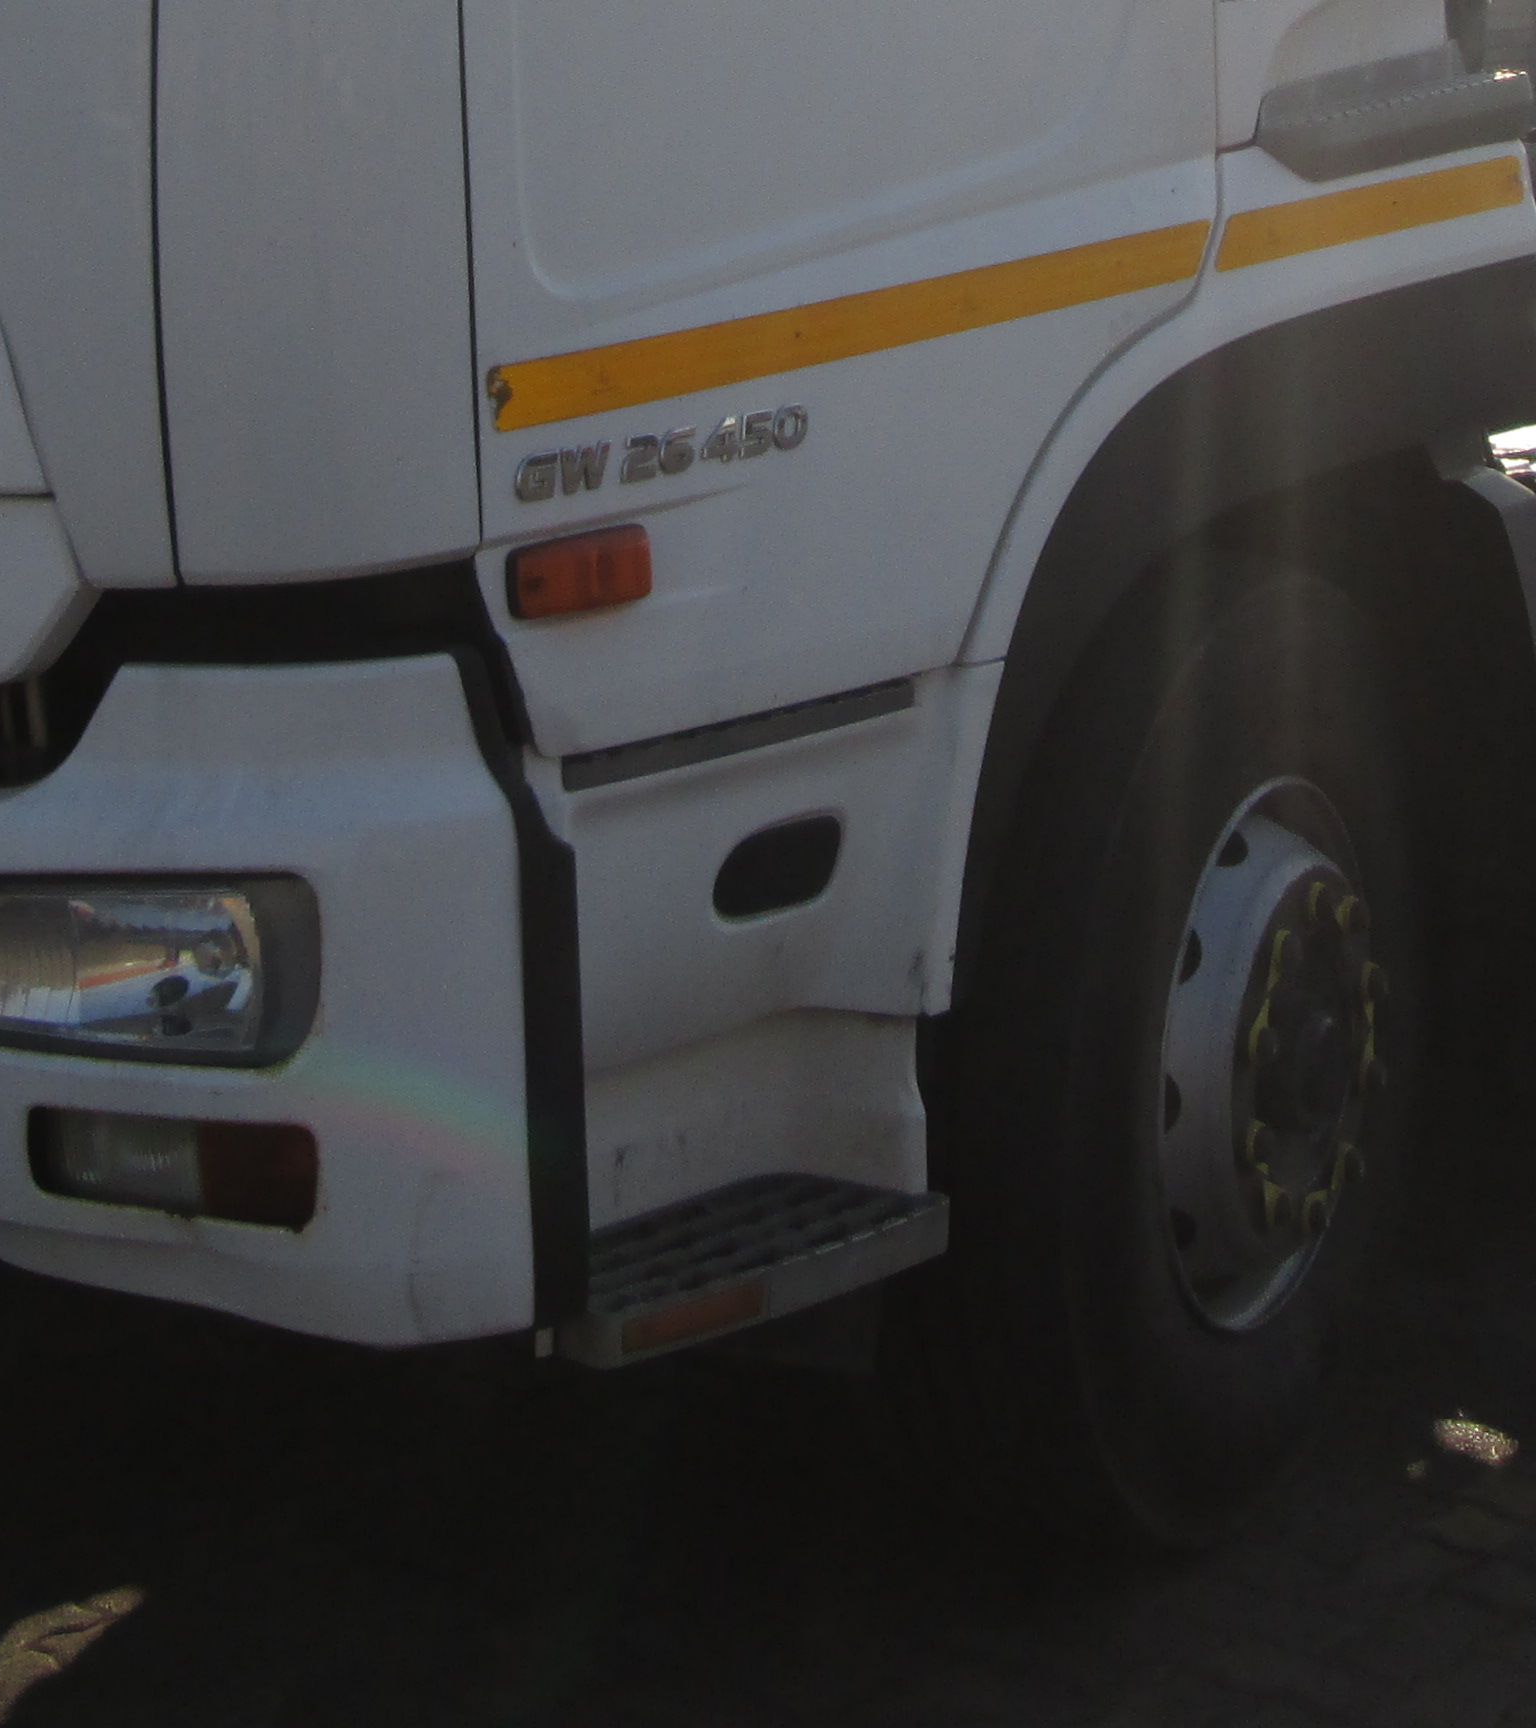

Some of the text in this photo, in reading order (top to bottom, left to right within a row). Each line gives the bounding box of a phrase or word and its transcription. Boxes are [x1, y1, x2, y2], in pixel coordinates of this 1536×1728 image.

[515, 402, 809, 503] GW 26 450
